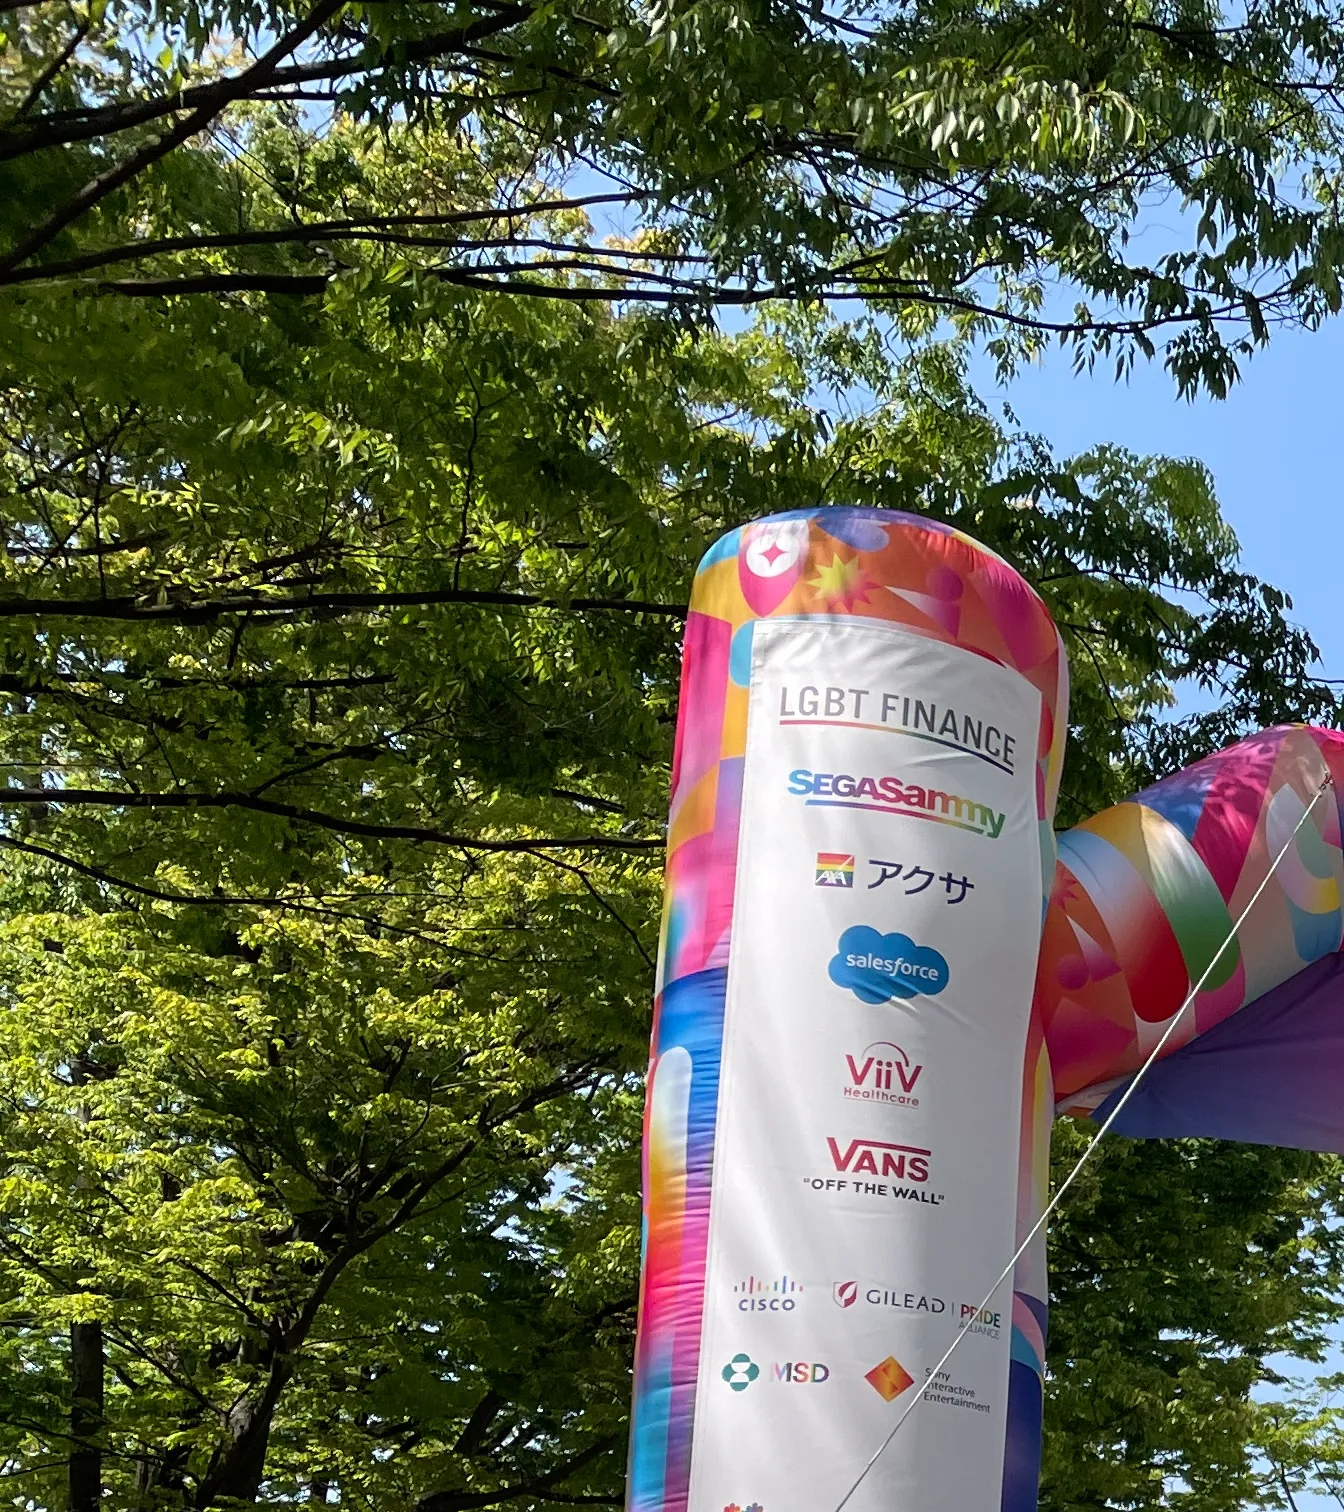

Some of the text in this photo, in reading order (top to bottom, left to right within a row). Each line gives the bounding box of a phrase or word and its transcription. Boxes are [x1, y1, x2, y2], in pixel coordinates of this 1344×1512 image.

[779, 685, 1016, 767] LGBT FINANCE
[816, 870, 847, 885] AXA
[867, 859, 975, 905] アクサ
[846, 953, 939, 981] salesforce
[845, 1054, 923, 1093] ViiV
[843, 1086, 919, 1107] Healthcare
[826, 1136, 932, 1182] VANS
[852, 1182, 888, 1196] THE
[866, 1289, 945, 1313] GILEAD
[961, 1303, 1001, 1328] PRIDE
[770, 1362, 830, 1383] MSD
[923, 1391, 991, 1413] Entertainment
